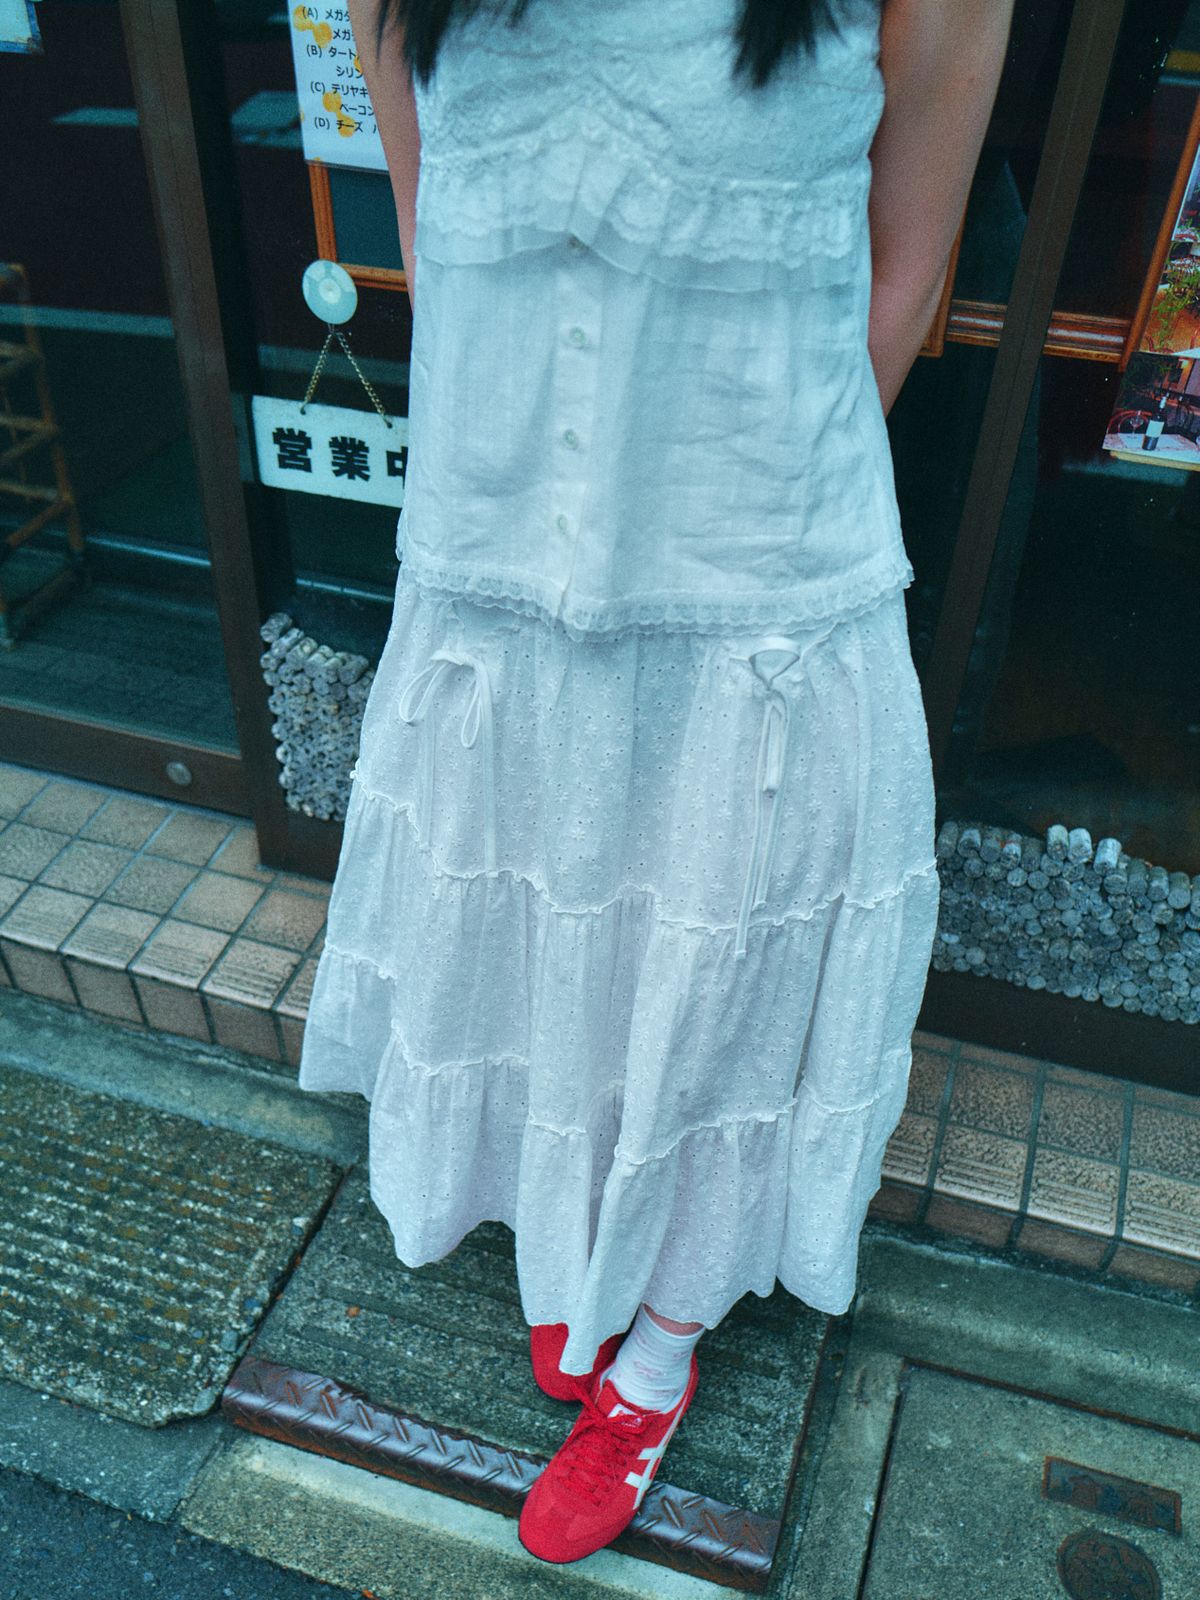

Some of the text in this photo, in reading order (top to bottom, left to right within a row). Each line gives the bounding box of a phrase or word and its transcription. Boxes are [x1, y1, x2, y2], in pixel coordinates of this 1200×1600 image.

[302, 7, 318, 20] (A)
[306, 44, 322, 58] (B)
[310, 81, 368, 98] (C) テリヤキ
[314, 117, 330, 130] (D)
[336, 120, 363, 133] チーズ
